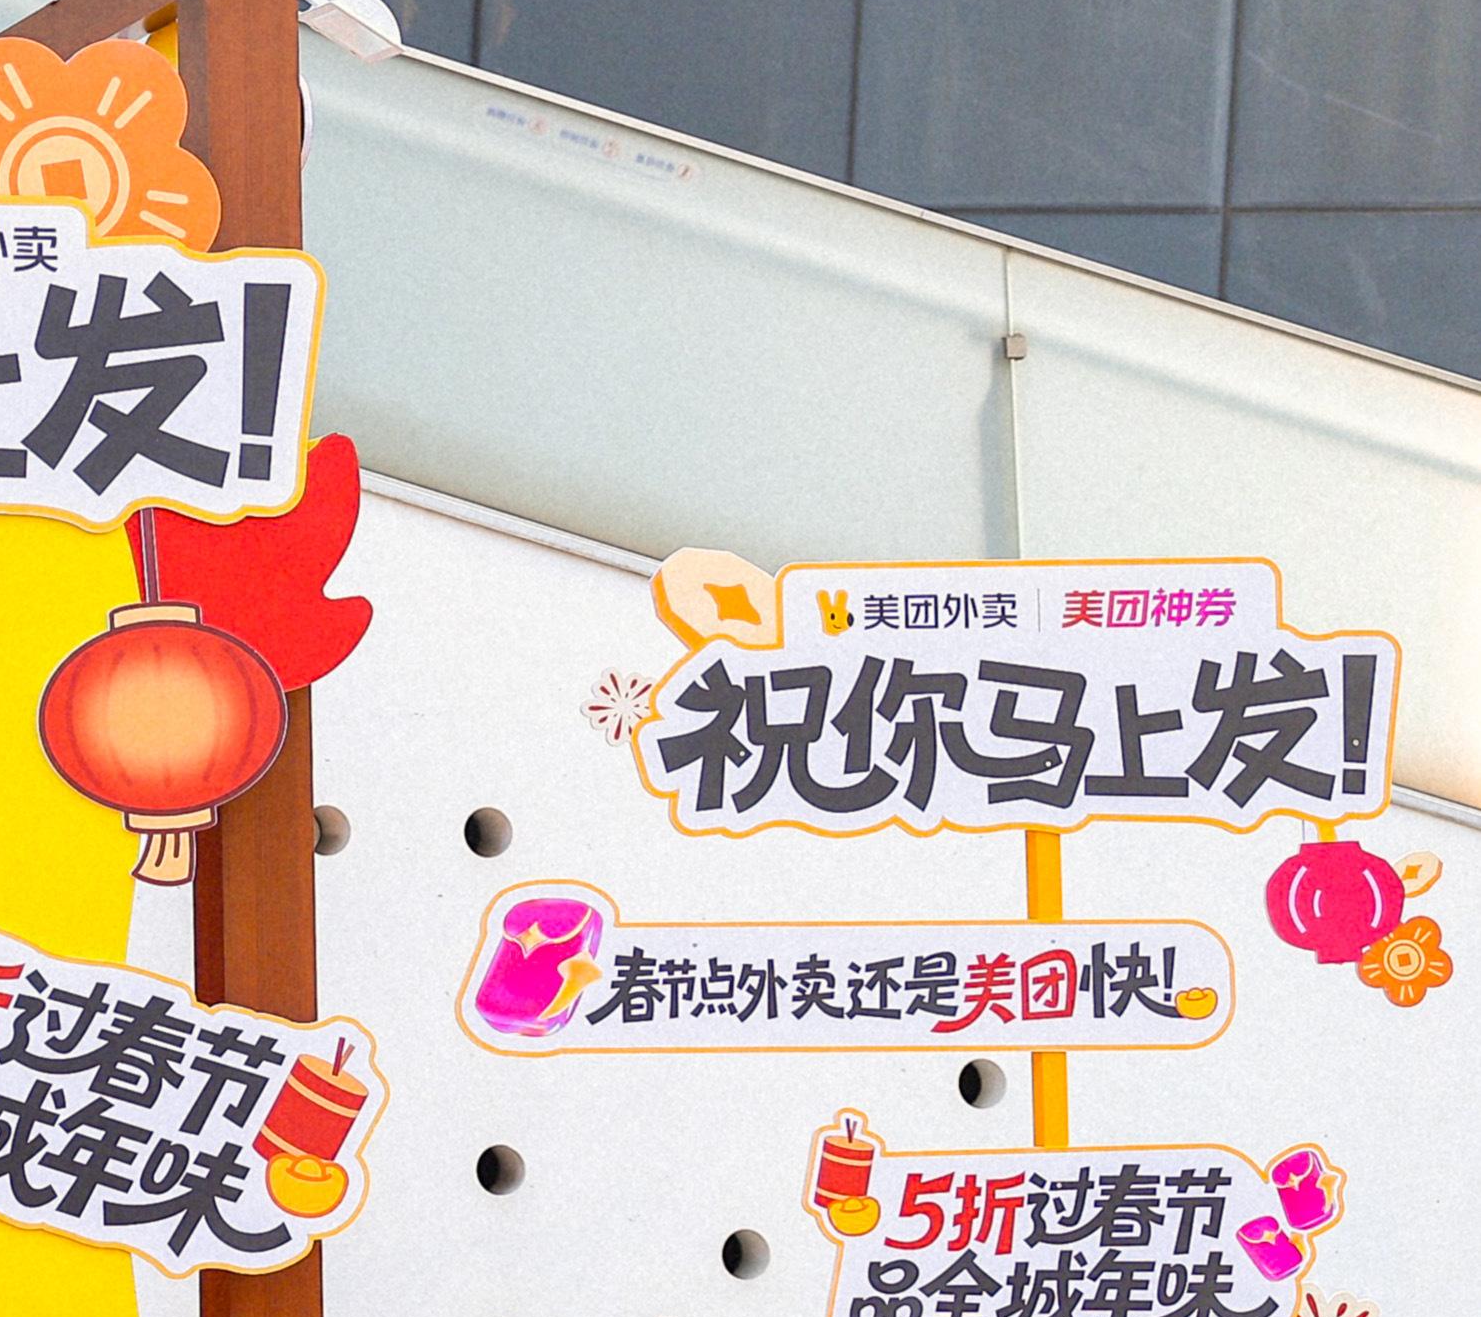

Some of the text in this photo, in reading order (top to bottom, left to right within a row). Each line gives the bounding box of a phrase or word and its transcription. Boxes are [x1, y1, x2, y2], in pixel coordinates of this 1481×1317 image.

[864, 589, 1236, 632] 美团外卖 美团神券
[658, 648, 1378, 813] 祝你马上发!
[585, 942, 1178, 1034] 春节点外卖还是美团快!
[884, 1163, 1234, 1256] 5折过春节
